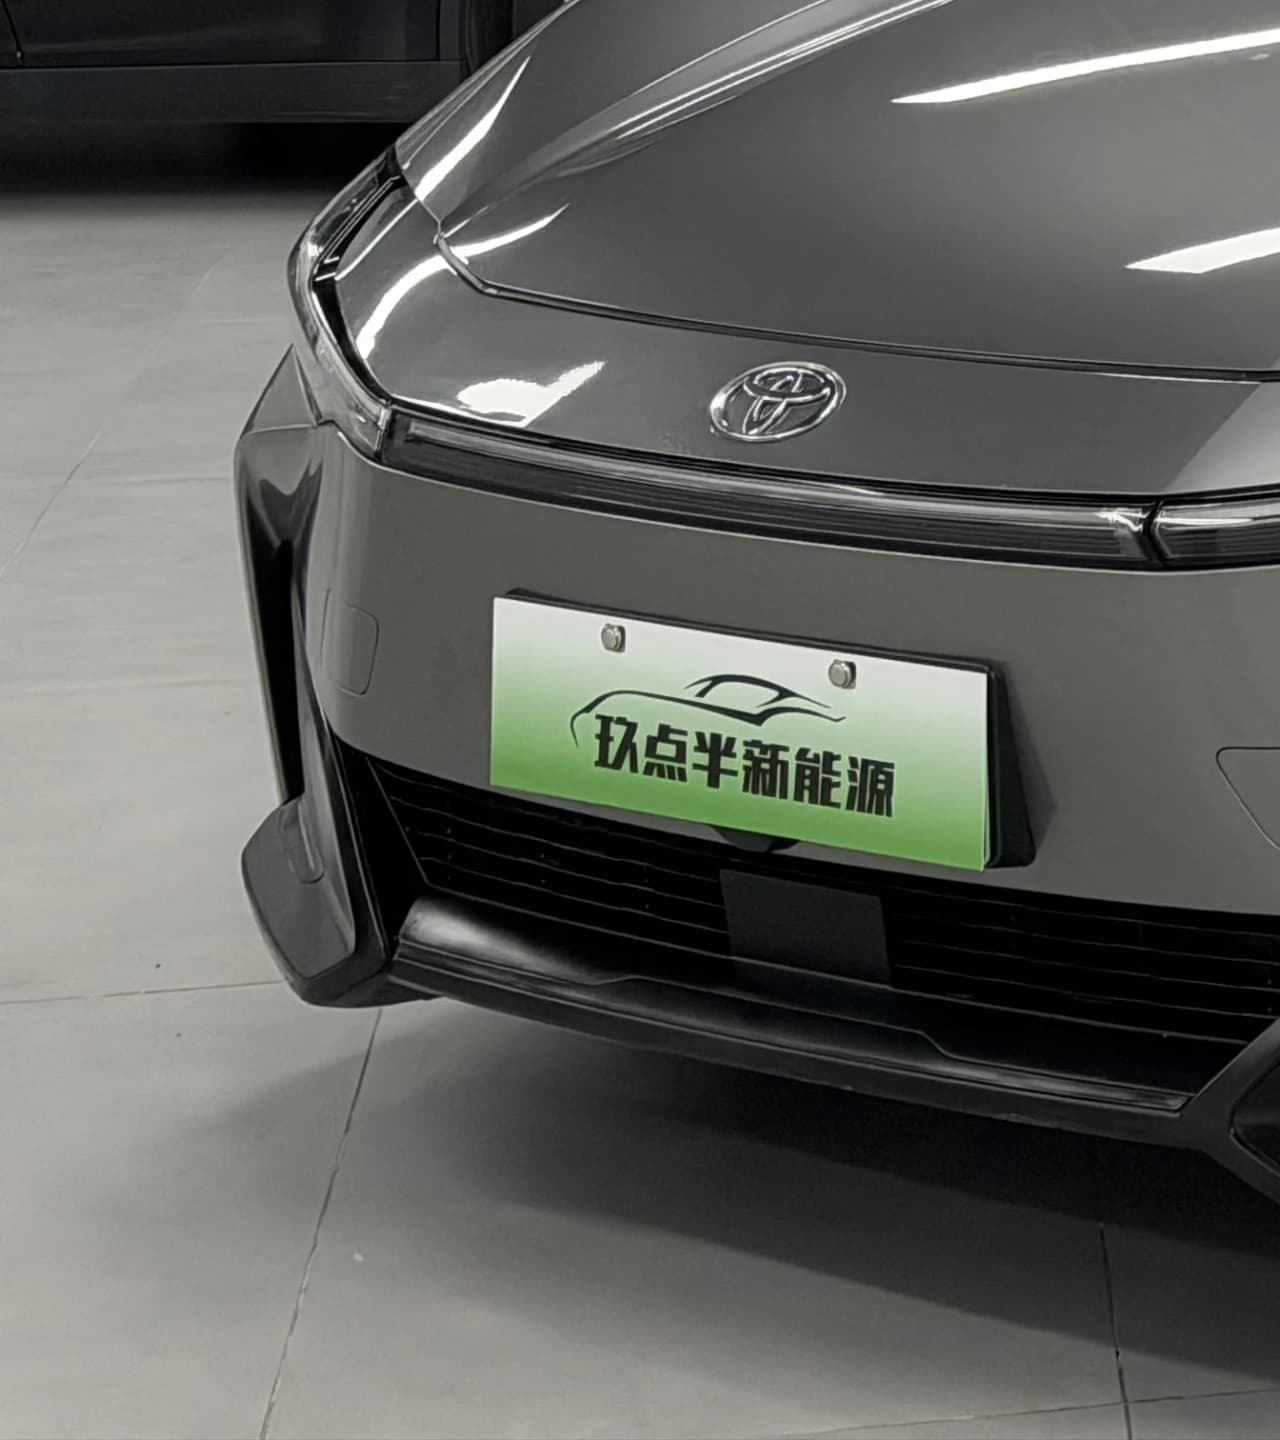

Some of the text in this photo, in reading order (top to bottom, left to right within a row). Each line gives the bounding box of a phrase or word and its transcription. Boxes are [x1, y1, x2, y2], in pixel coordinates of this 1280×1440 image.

[594, 713, 896, 818] 玖点半新能源
